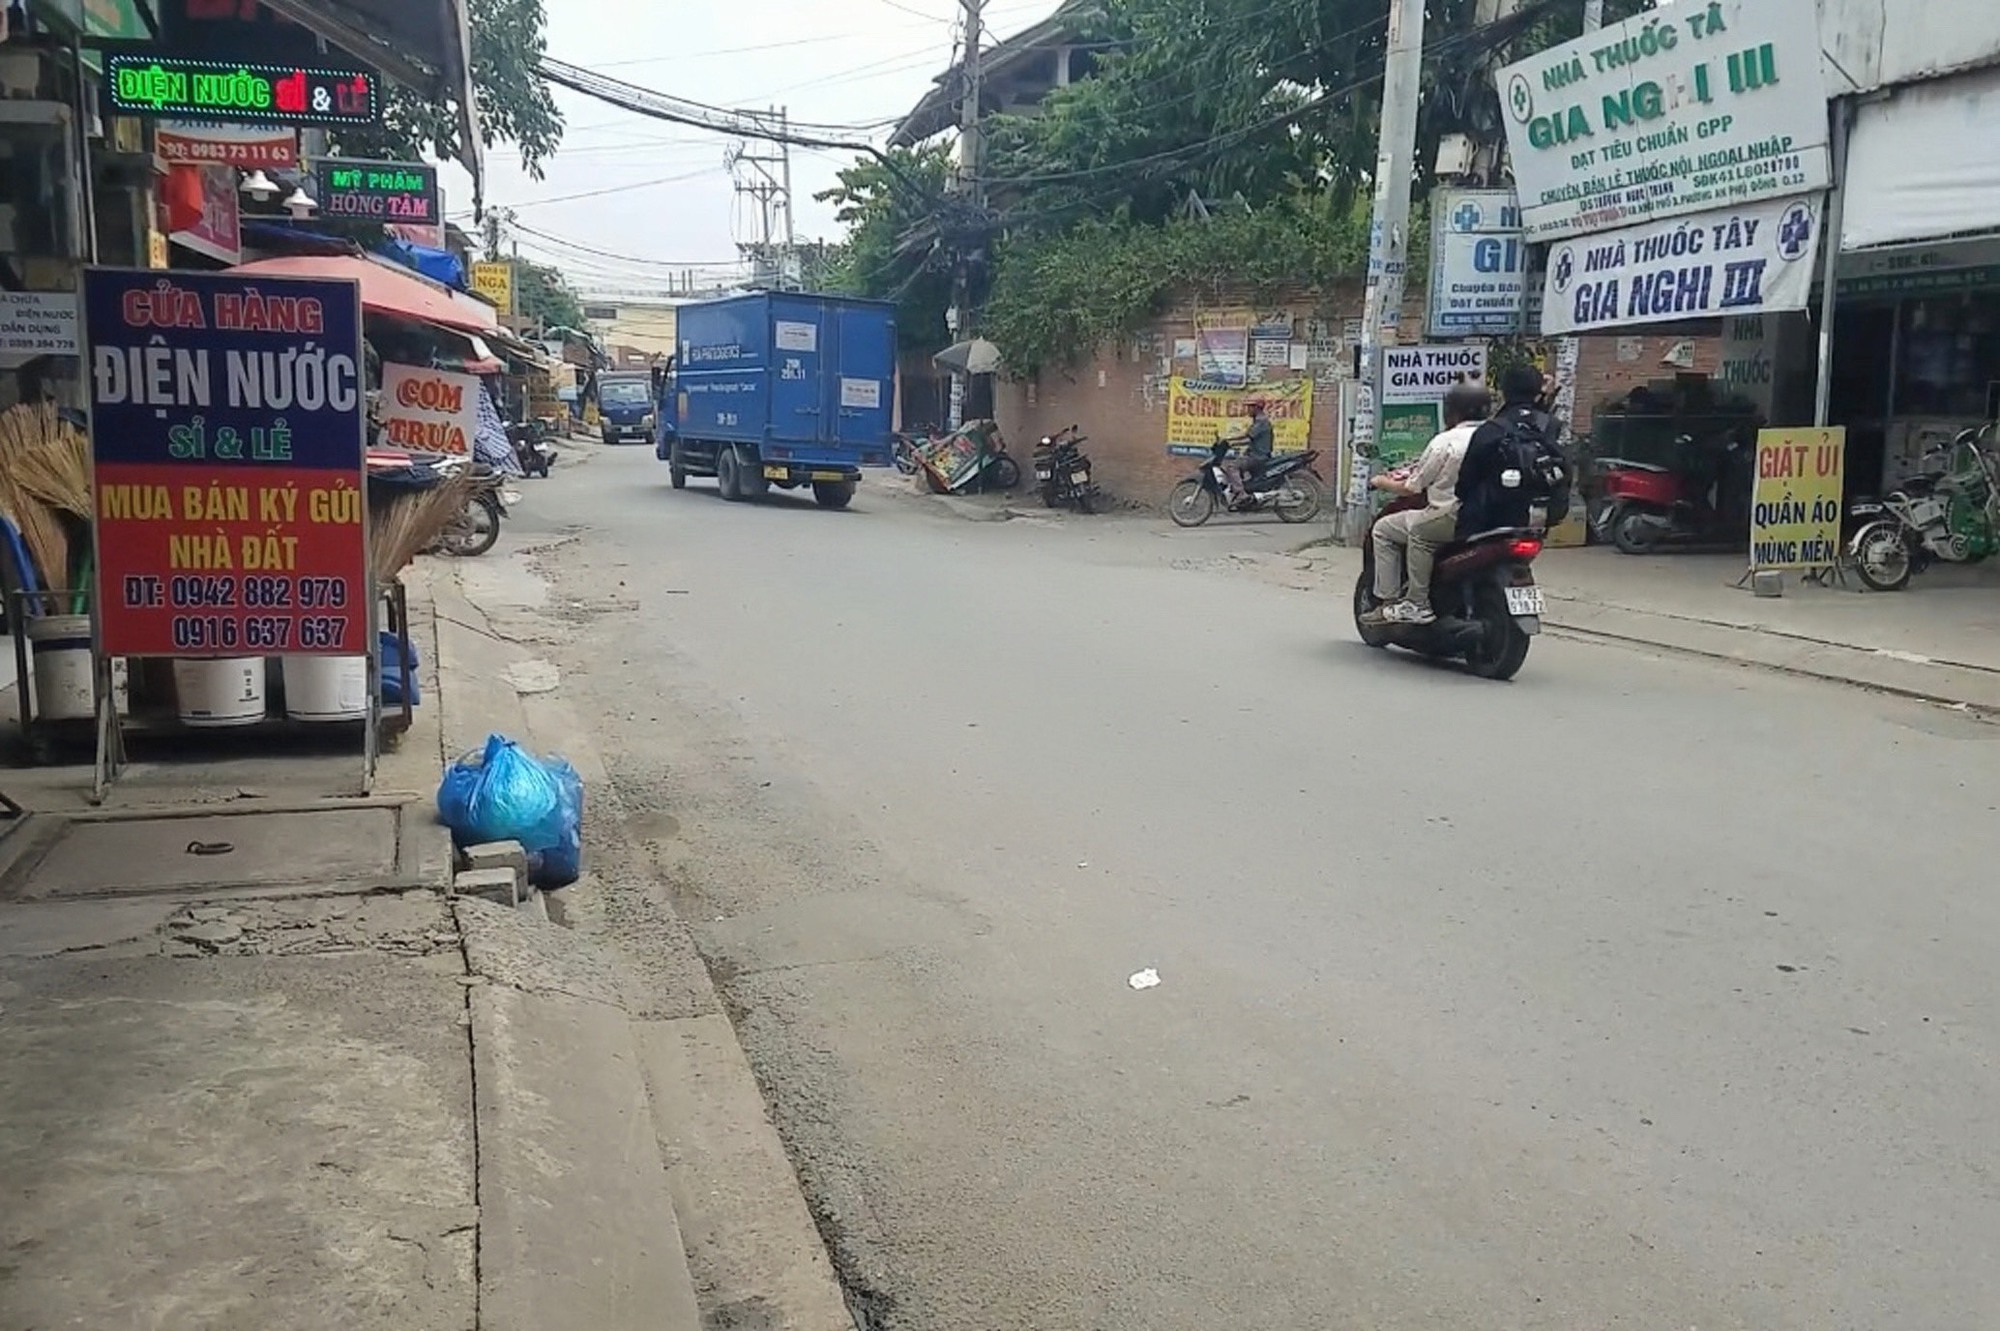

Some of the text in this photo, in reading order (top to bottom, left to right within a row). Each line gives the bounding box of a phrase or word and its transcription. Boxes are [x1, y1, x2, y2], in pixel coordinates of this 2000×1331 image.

[1542, 1, 1728, 91] NHÀ THUỐC TÂ
[118, 65, 187, 109] ĐIỆN
[193, 69, 270, 108] NƯỚC
[312, 86, 331, 111] &
[1528, 43, 1780, 149] GIA NGI III
[230, 145, 248, 159] 73
[251, 146, 267, 159] 11
[1571, 115, 1733, 170] ĐẠT TIÊU CHUẨN GPP
[1627, 160, 1668, 185] THUỐC
[1671, 155, 1693, 179] NỘI
[1698, 146, 1744, 171] NGOẠI
[1748, 135, 1792, 160] NHẬP
[331, 189, 428, 217] HỒNG TÂM
[1474, 238, 1523, 273] GI
[1585, 216, 1760, 272] NHÀ THUỐC TÂY
[477, 276, 507, 289] NGA
[1574, 259, 1767, 324] GIA NGHI III
[123, 279, 324, 333] CỬA HÀNG
[94, 335, 356, 418] ĐIỆN NƯỚC
[1388, 348, 1481, 368] NHÀ THUỐC
[1391, 371, 1419, 387] GIA
[397, 378, 463, 413] CƠM
[168, 415, 292, 460] SỈ & LẺ
[386, 417, 469, 455] TRƯA
[1760, 432, 1838, 487] GIẶT ỦI
[102, 479, 361, 524] MUA BÁN KÝ GỬI
[1755, 492, 1837, 530] QUẦN ÁO
[170, 524, 298, 570] NHÀ ĐẤT
[1754, 530, 1834, 564] MÙNG MỀN
[124, 575, 346, 609] ĐT: 0942 882 979
[173, 616, 347, 648] 0916 637 637
